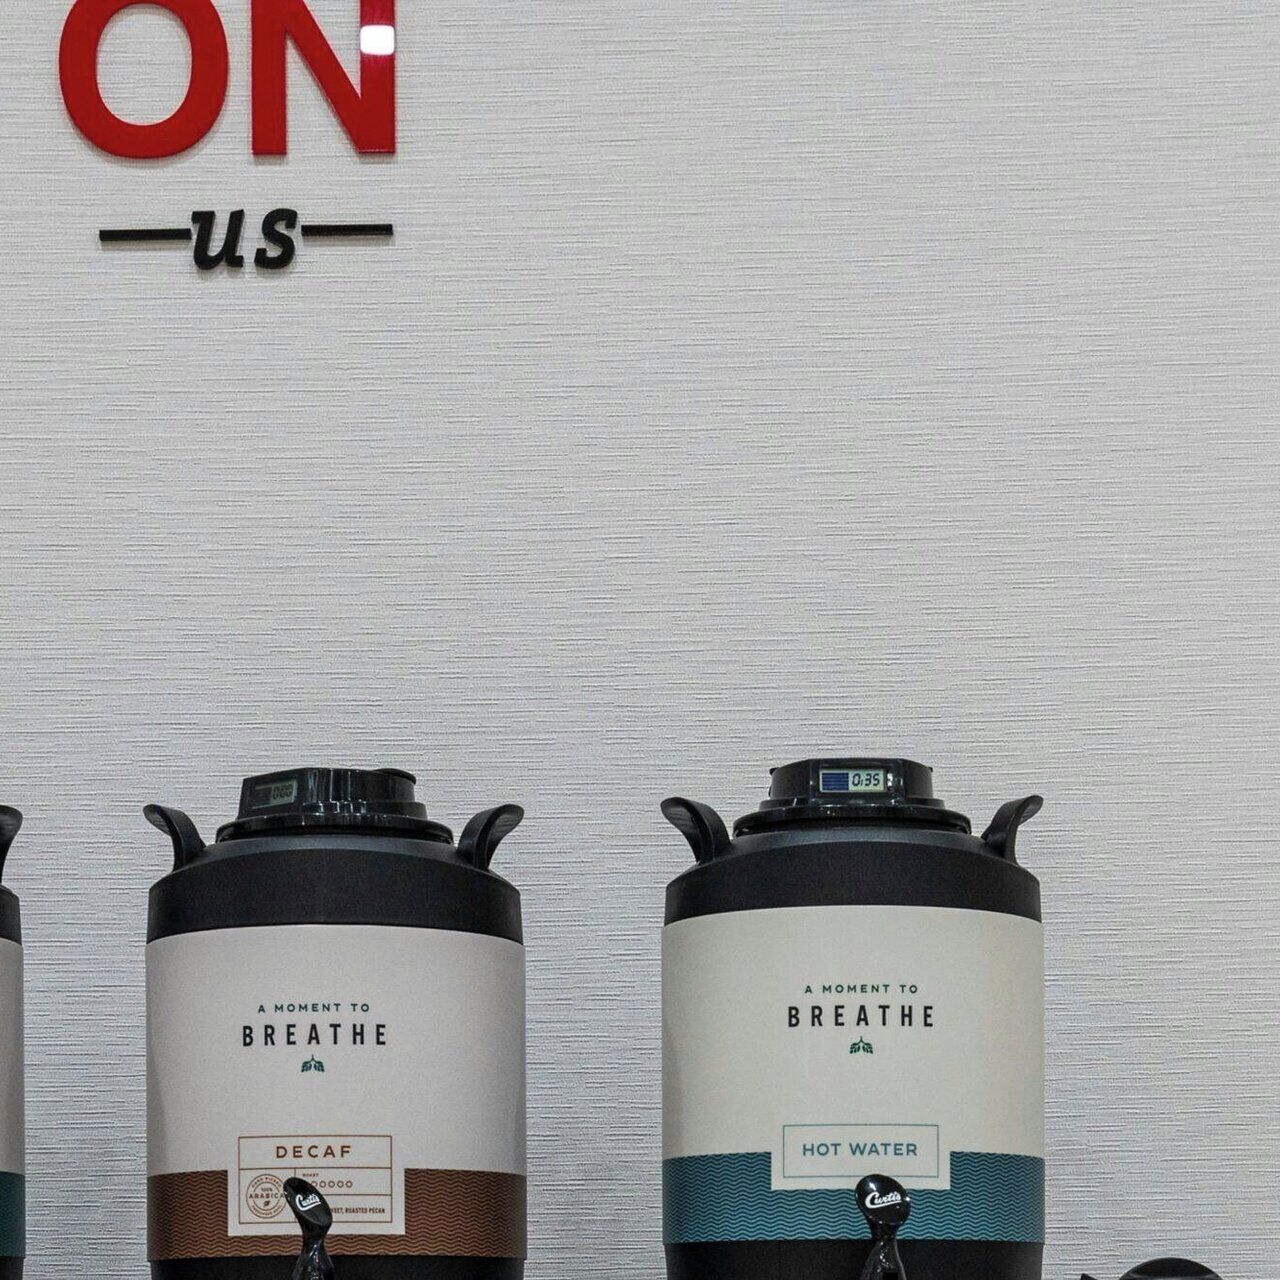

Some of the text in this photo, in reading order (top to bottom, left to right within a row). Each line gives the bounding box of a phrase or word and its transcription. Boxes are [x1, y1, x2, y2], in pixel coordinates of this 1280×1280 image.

[59, 0, 396, 158] ON
[191, 209, 298, 270] us
[852, 772, 880, 787] 0:35
[804, 984, 918, 994] A MOMENT TO
[258, 1003, 370, 1013] A MOMENT TO
[788, 1004, 934, 1028] BREATHE
[242, 1023, 386, 1047] BREATHE
[276, 1145, 351, 1159] DECAF
[802, 1142, 918, 1156] HOT WATER
[865, 1191, 902, 1209] Curtis
